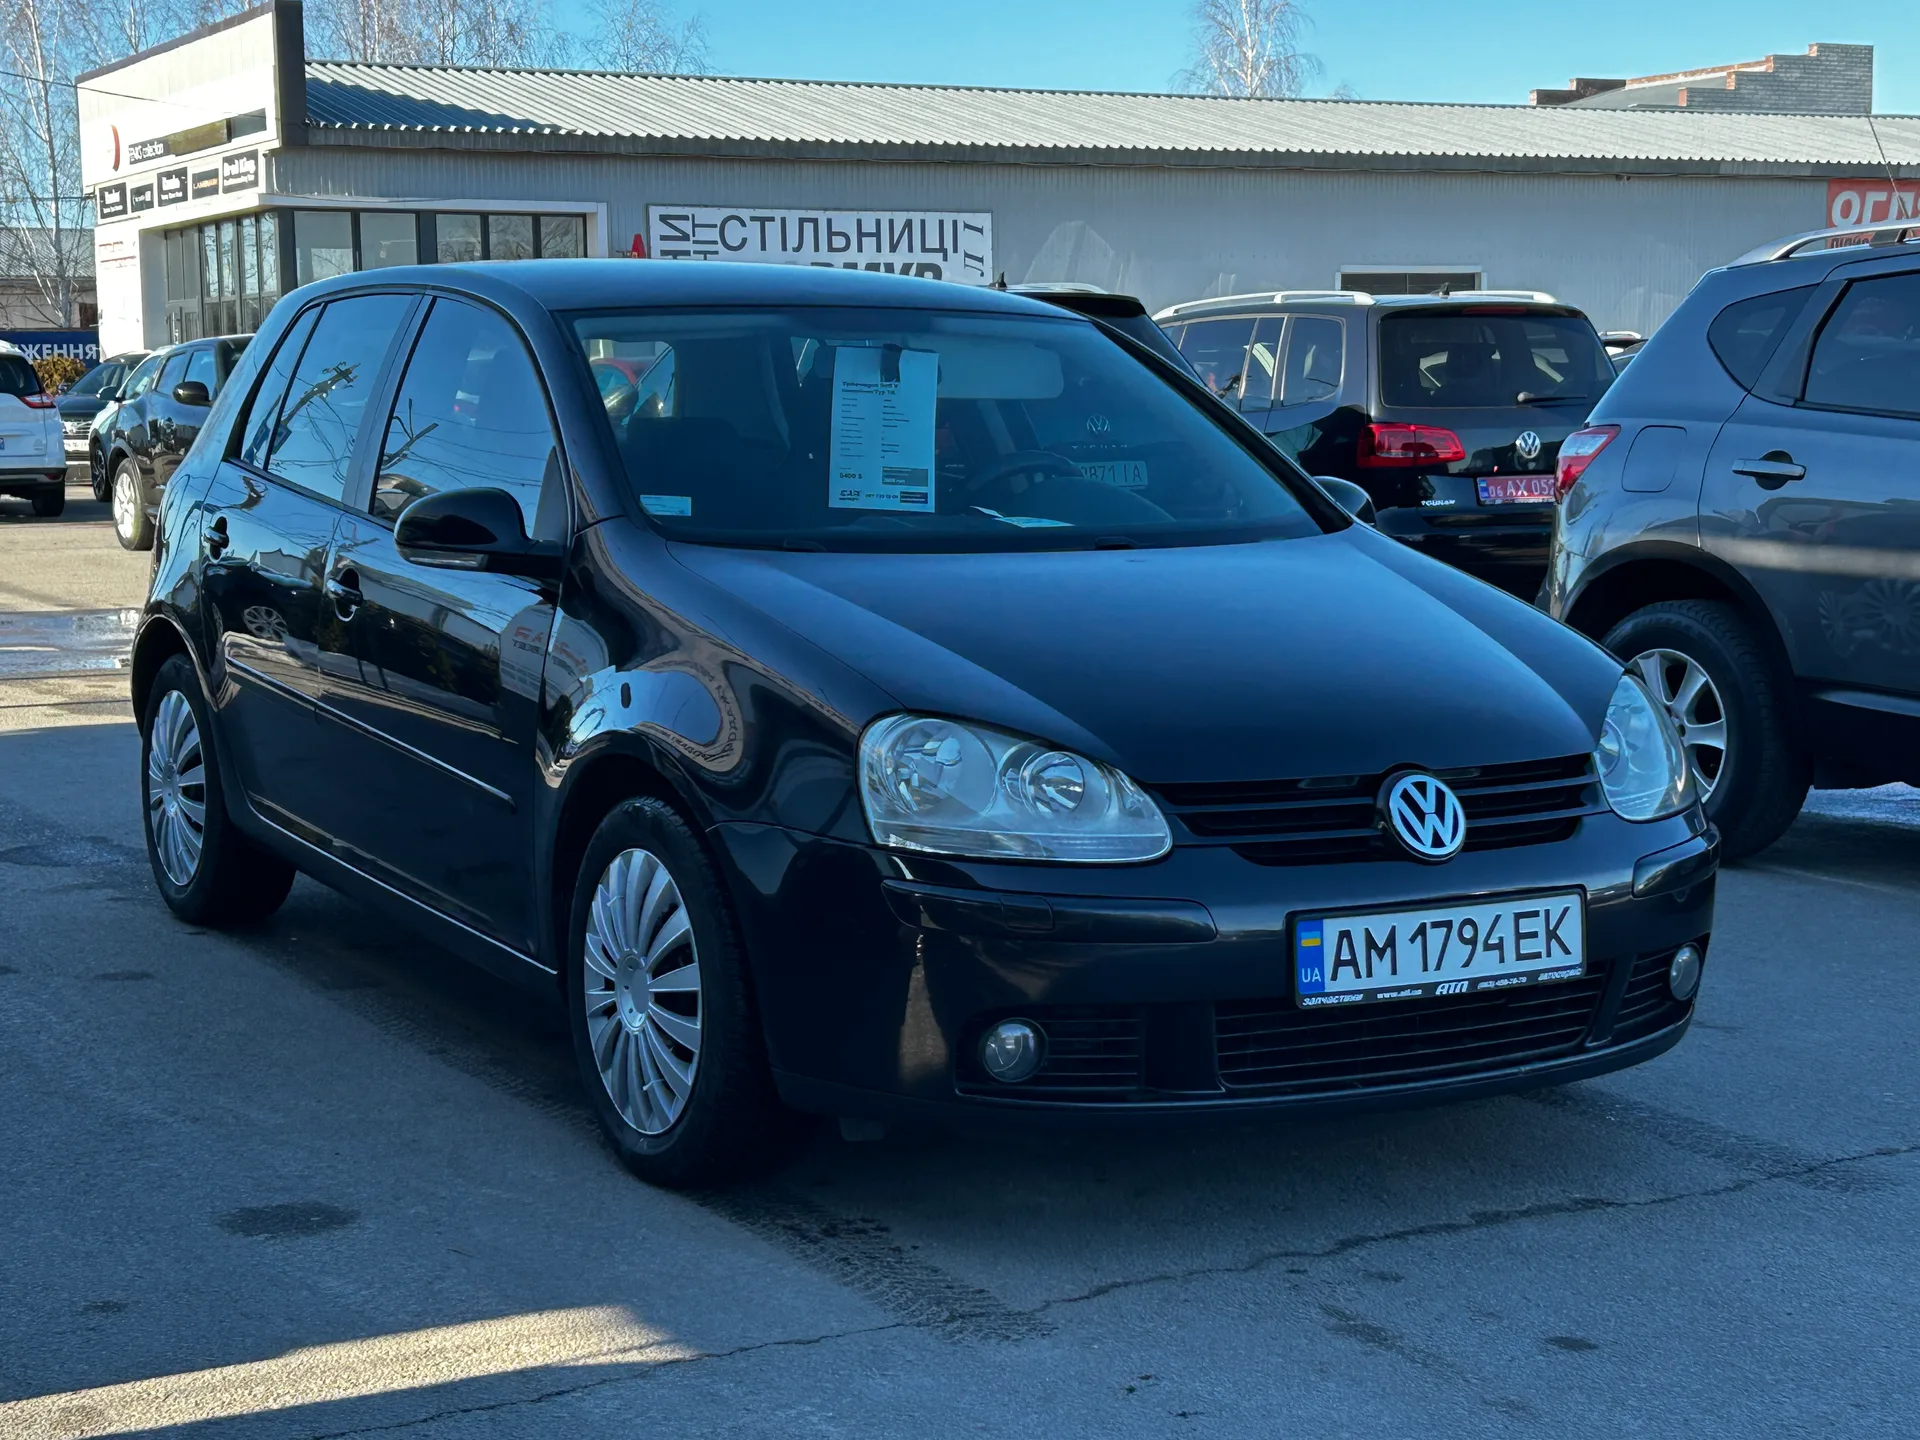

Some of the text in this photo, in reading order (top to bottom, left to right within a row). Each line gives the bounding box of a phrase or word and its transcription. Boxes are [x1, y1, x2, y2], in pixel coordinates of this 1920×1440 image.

[1831, 190, 1920, 228] ОГЛ
[718, 214, 959, 262] СТІЛЬНИЦІ
[18, 343, 97, 360] ЖЕННЯ
[1507, 480, 1528, 496] AX
[1301, 967, 1322, 983] UA
